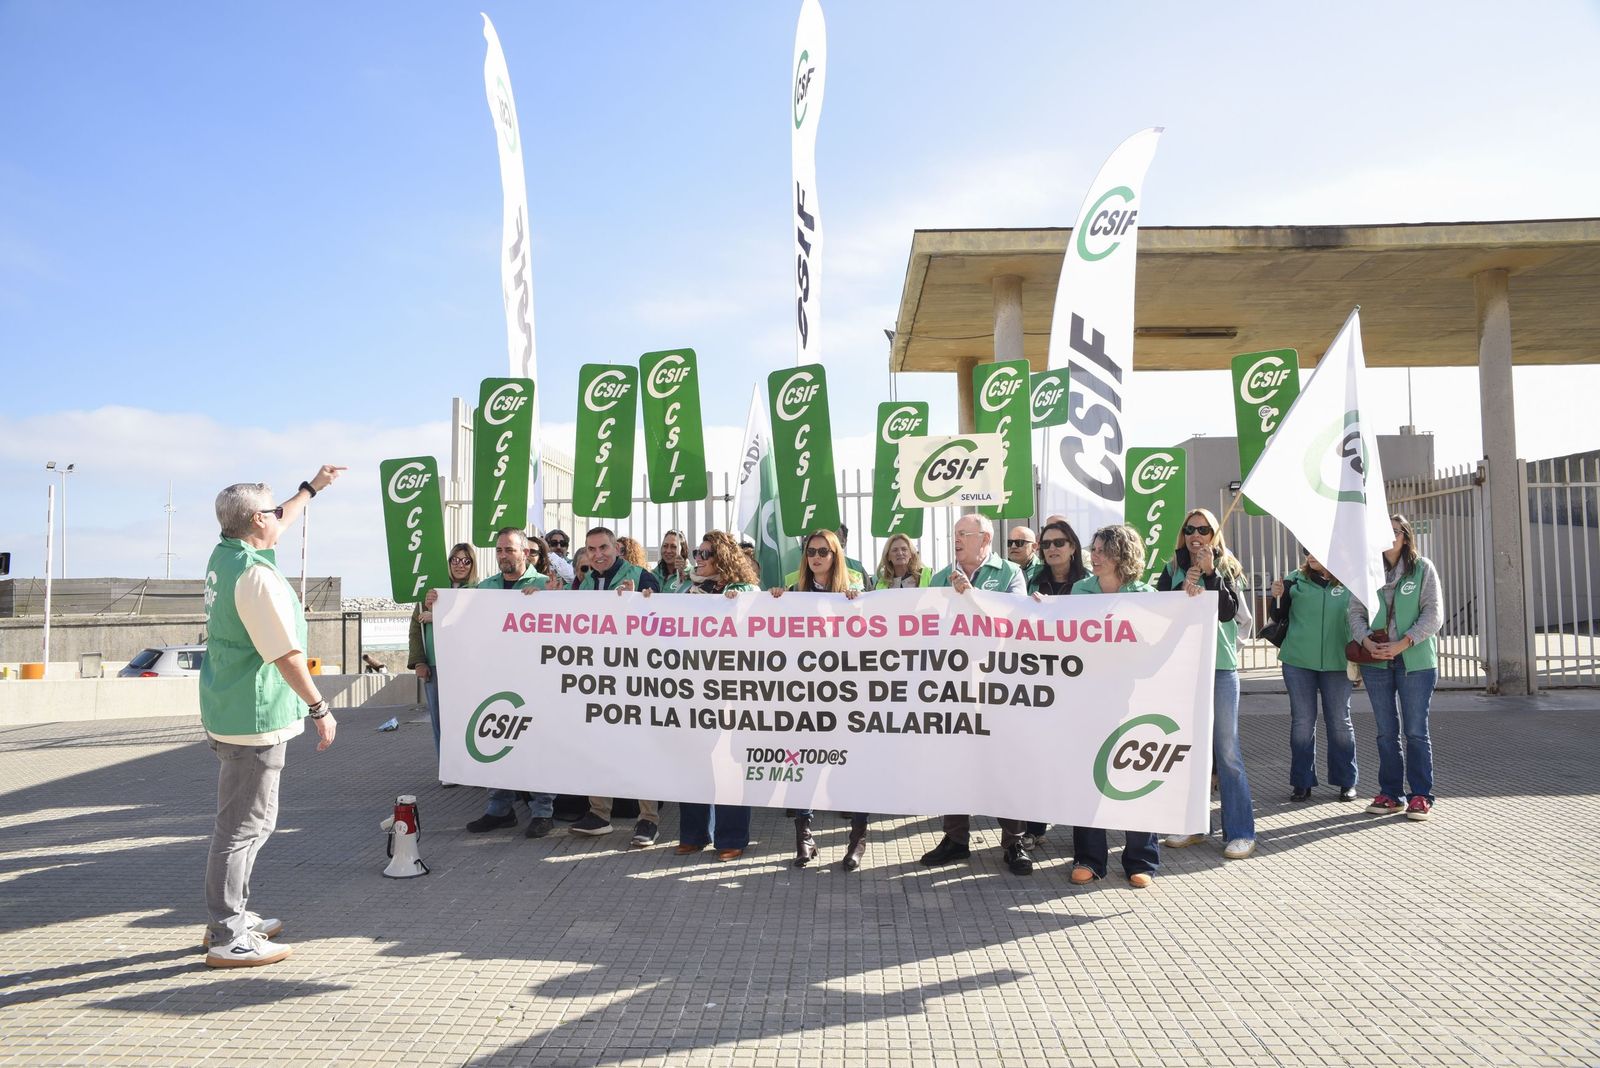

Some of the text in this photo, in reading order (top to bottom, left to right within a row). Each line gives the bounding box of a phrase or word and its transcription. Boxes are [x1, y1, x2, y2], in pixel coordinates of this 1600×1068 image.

[1089, 209, 1138, 237] CSIF
[655, 367, 691, 385] CSIF
[988, 379, 1023, 398] CSIF
[1250, 369, 1291, 389] CSIF
[492, 396, 528, 412] CSIF
[593, 382, 631, 399] CSIF
[784, 384, 820, 406] CSIF
[1034, 388, 1065, 408] CSIF
[1060, 311, 1125, 502] CSIF
[889, 417, 923, 432] CSIF
[664, 402, 685, 497] CSIF
[489, 430, 513, 526] CSIF
[591, 417, 616, 512] CSIF
[794, 424, 817, 529] CSIF
[1141, 465, 1179, 481] CSIF
[396, 473, 432, 491] CSIF
[961, 493, 992, 501] SEVILLA
[406, 506, 428, 597] CSIF
[502, 611, 1138, 643] AGENCIA PÚBLICA PUERTOS DE ANDALUCÍA
[540, 644, 1084, 678] POR UN CONVENIO COLECTIVO JUSTO
[560, 673, 1055, 708] POR UNOS SERVICIOS DE CALIDAD
[478, 712, 533, 741] CSIF
[585, 702, 991, 736] POR LA IGUALDAD SALARIAL
[1112, 739, 1192, 773] CSIF
[745, 763, 805, 783] ES MÁS
